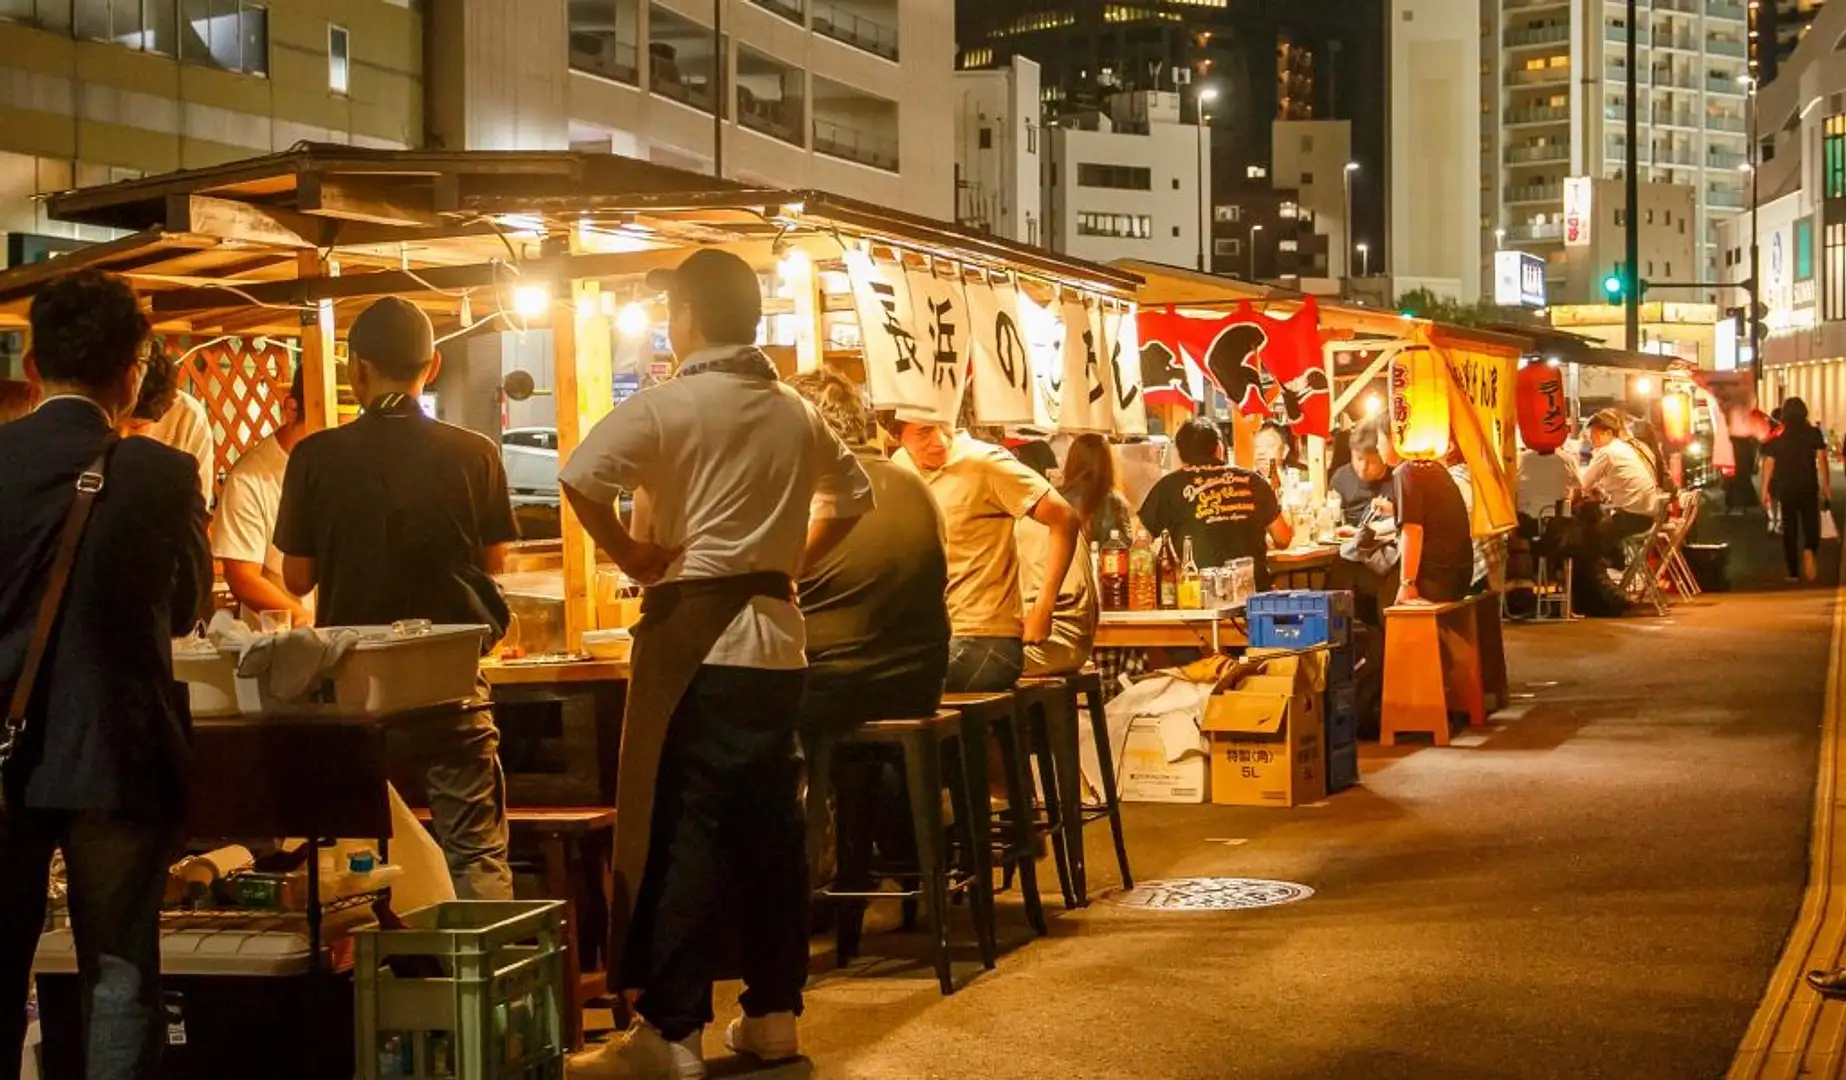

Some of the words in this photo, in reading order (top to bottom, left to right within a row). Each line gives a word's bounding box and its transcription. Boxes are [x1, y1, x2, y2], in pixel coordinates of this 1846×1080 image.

[1538, 380, 1563, 434] ラーメン
[1241, 766, 1261, 778] 5L
